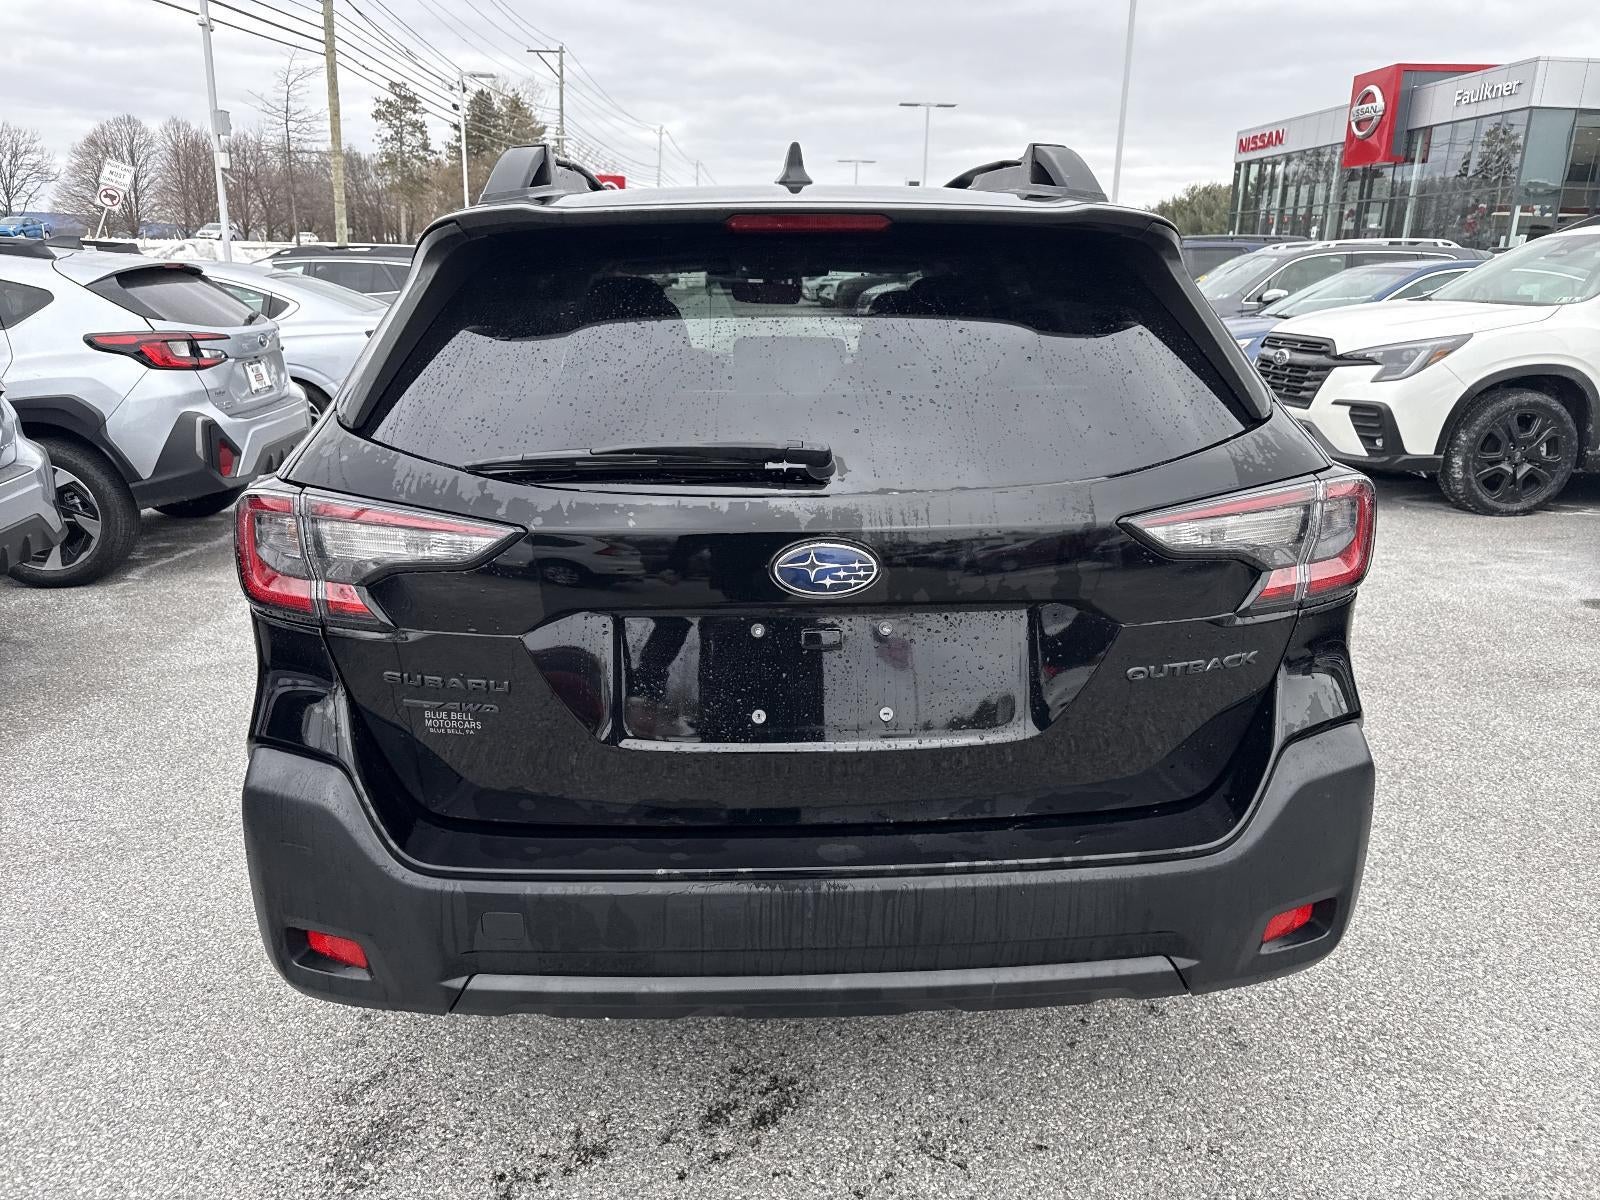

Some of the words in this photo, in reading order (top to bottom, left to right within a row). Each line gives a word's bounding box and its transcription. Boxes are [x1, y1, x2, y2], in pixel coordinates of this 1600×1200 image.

[1454, 80, 1520, 106] Faulkner
[1238, 128, 1285, 154] NISSAN
[109, 170, 126, 179] MUST
[1126, 650, 1259, 681] OUTBACK
[383, 671, 511, 693] SUBARU
[438, 702, 499, 713] AWD
[425, 711, 448, 720] BLUE
[450, 712, 474, 721] BELL
[425, 719, 482, 729] MOTORCARS
